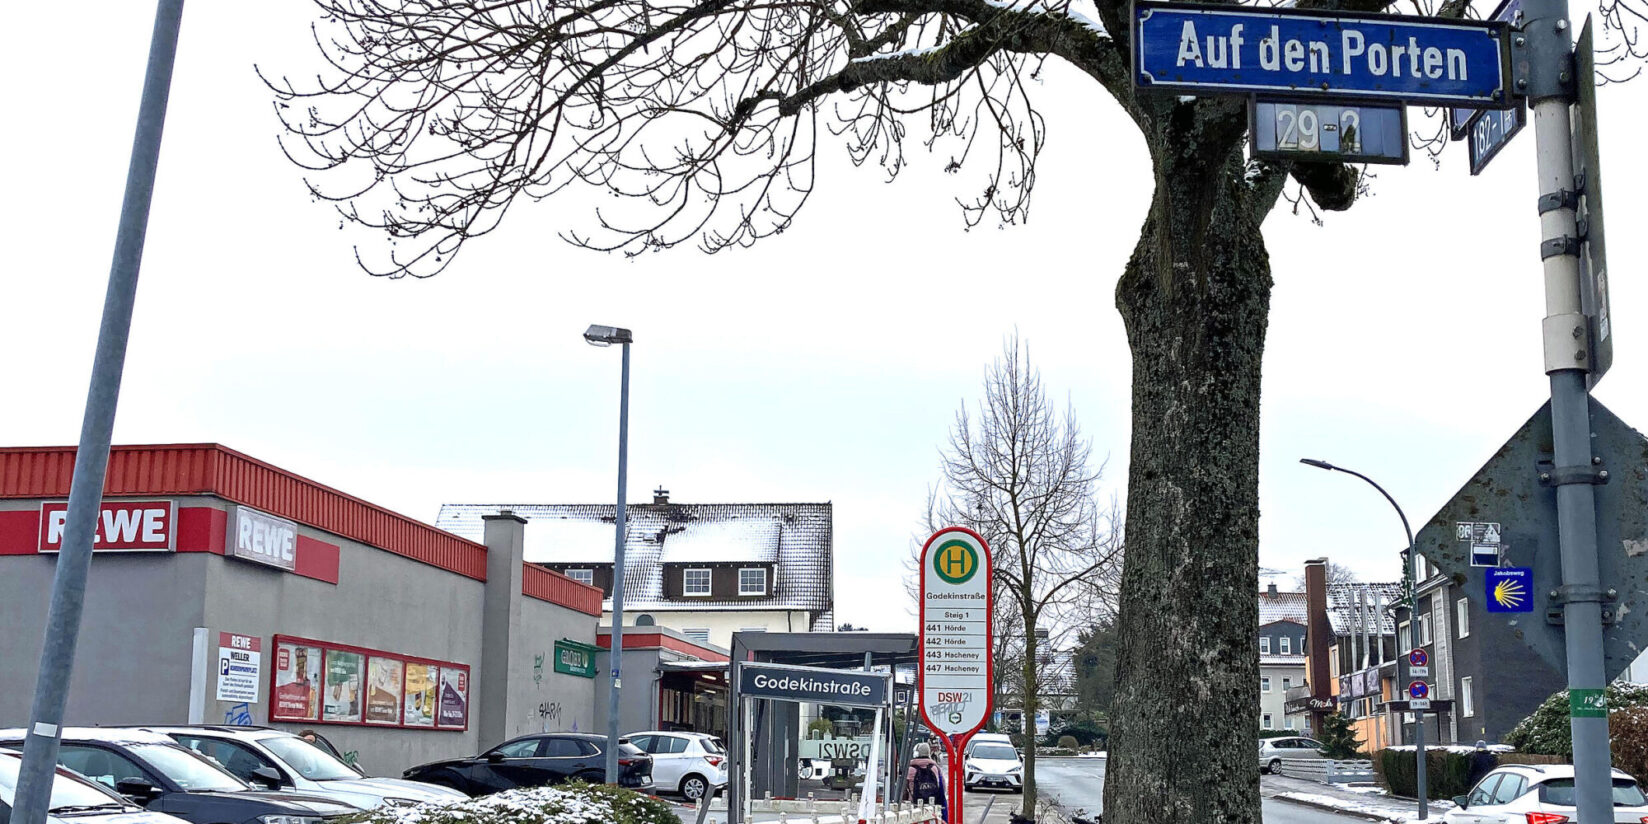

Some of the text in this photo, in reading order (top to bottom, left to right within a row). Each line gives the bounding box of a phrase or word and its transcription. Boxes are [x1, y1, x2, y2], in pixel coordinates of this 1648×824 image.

[1176, 20, 1468, 80] Auf den Porten
[47, 509, 166, 544] RWE
[238, 516, 293, 561] REWE
[926, 592, 985, 600] Godekinstraße
[944, 611, 963, 619] Steig
[926, 624, 966, 632] 441 Hörde
[231, 635, 251, 649] REWE
[944, 651, 979, 659] Hacheney
[944, 665, 979, 673] Hacheney
[754, 674, 871, 696] Godekinstraße
